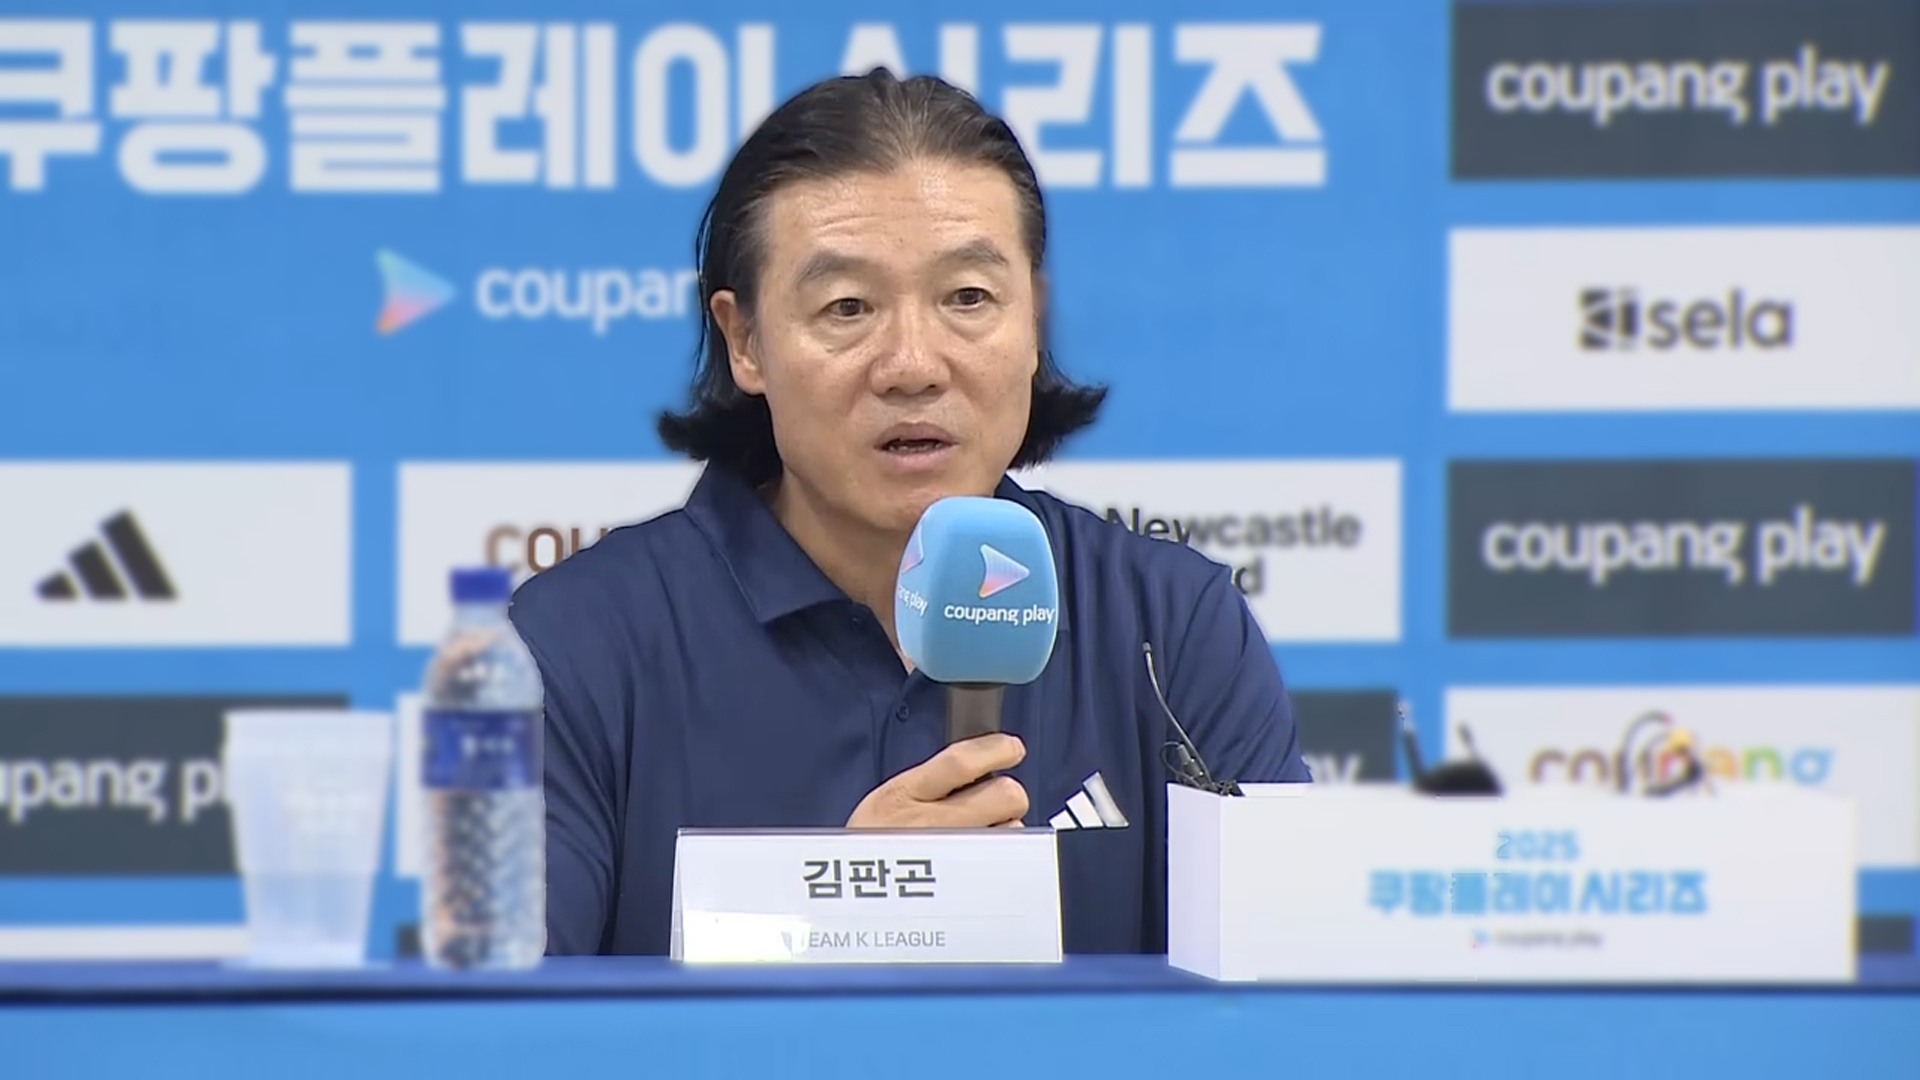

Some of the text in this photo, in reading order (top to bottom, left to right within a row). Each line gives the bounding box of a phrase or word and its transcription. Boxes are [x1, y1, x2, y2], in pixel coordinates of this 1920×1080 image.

[0, 20, 774, 194] 쿠팡플레이
[1486, 43, 1888, 126] coupang play
[1646, 288, 1794, 350] sela
[1483, 506, 1884, 585] coupang play
[944, 604, 1055, 626] coupang play
[0, 760, 167, 823] pang
[802, 859, 936, 899] 김판곤
[856, 931, 868, 947] K
[874, 931, 945, 947] LEAGUE
